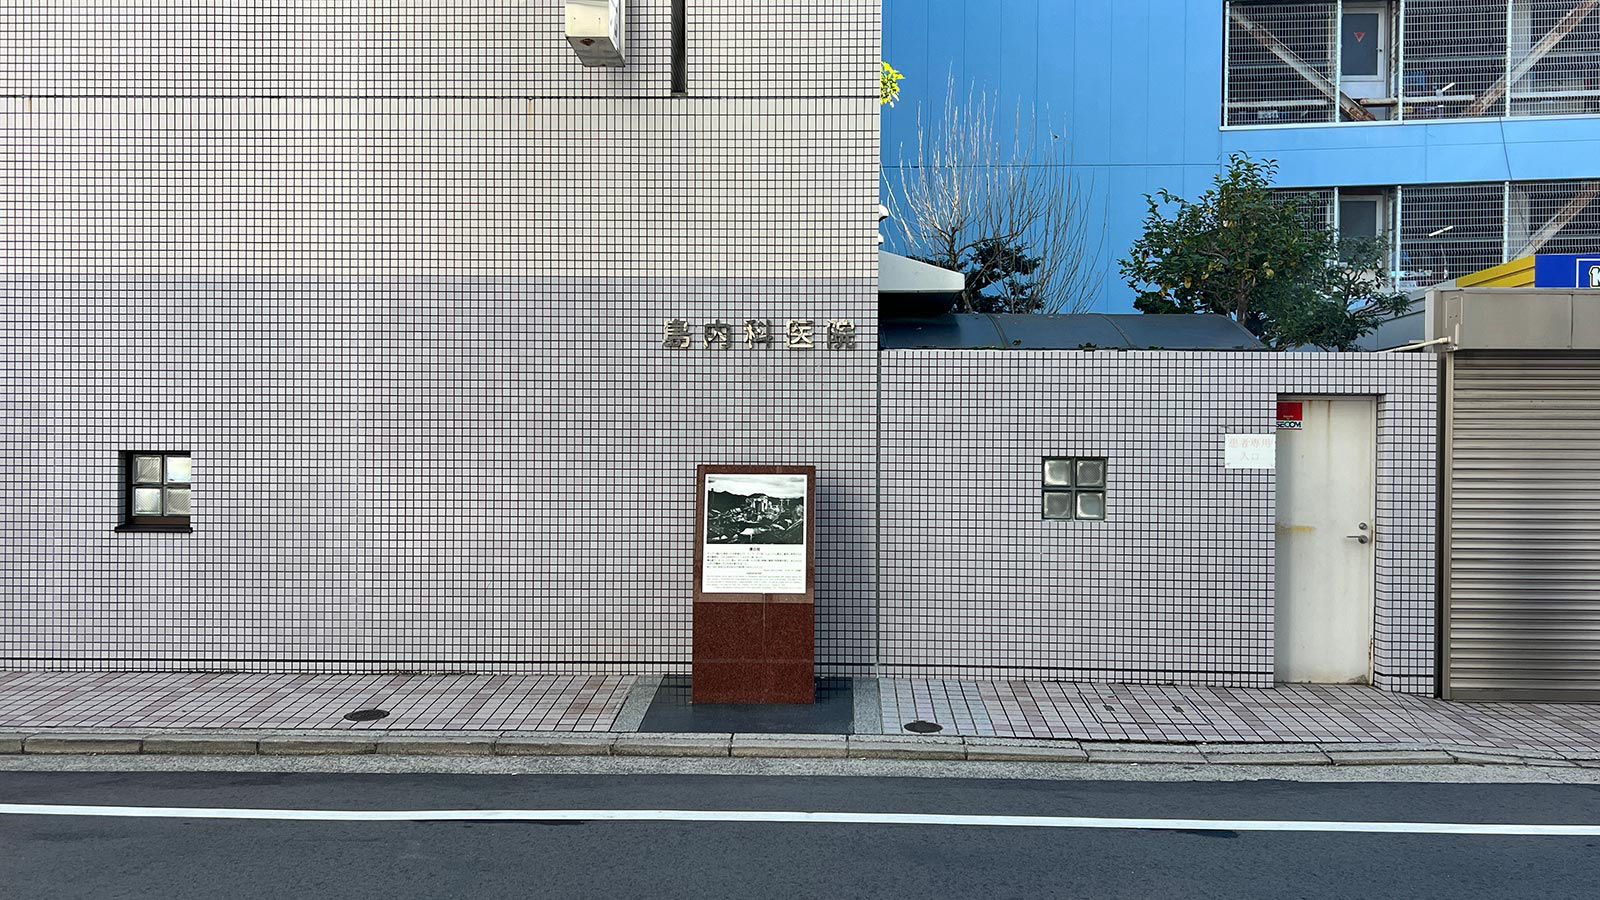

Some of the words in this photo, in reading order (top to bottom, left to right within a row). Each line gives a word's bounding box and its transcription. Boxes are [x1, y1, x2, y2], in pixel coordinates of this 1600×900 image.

[662, 319, 856, 350] 島内科医院
[1240, 451, 1260, 461] 入口
